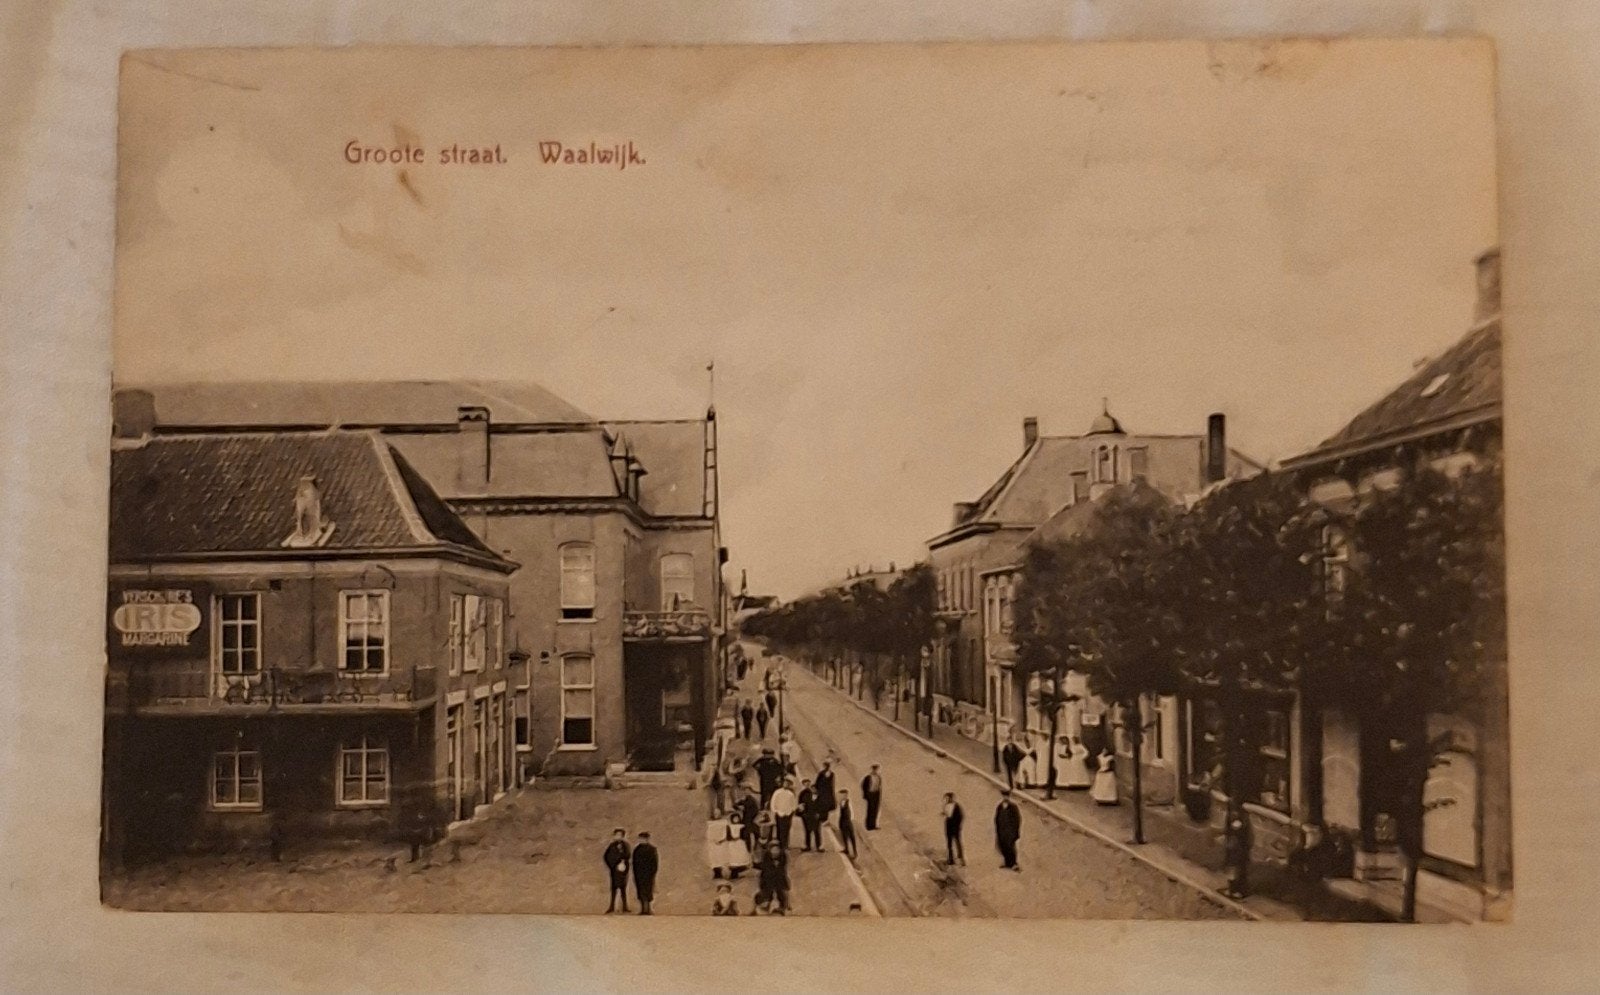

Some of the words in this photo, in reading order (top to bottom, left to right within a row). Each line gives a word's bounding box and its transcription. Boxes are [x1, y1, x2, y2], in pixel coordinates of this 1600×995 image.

[344, 140, 425, 164] Groote
[439, 143, 508, 164] straat.
[538, 140, 647, 171] Waalwijk.
[124, 606, 194, 630] IRIS
